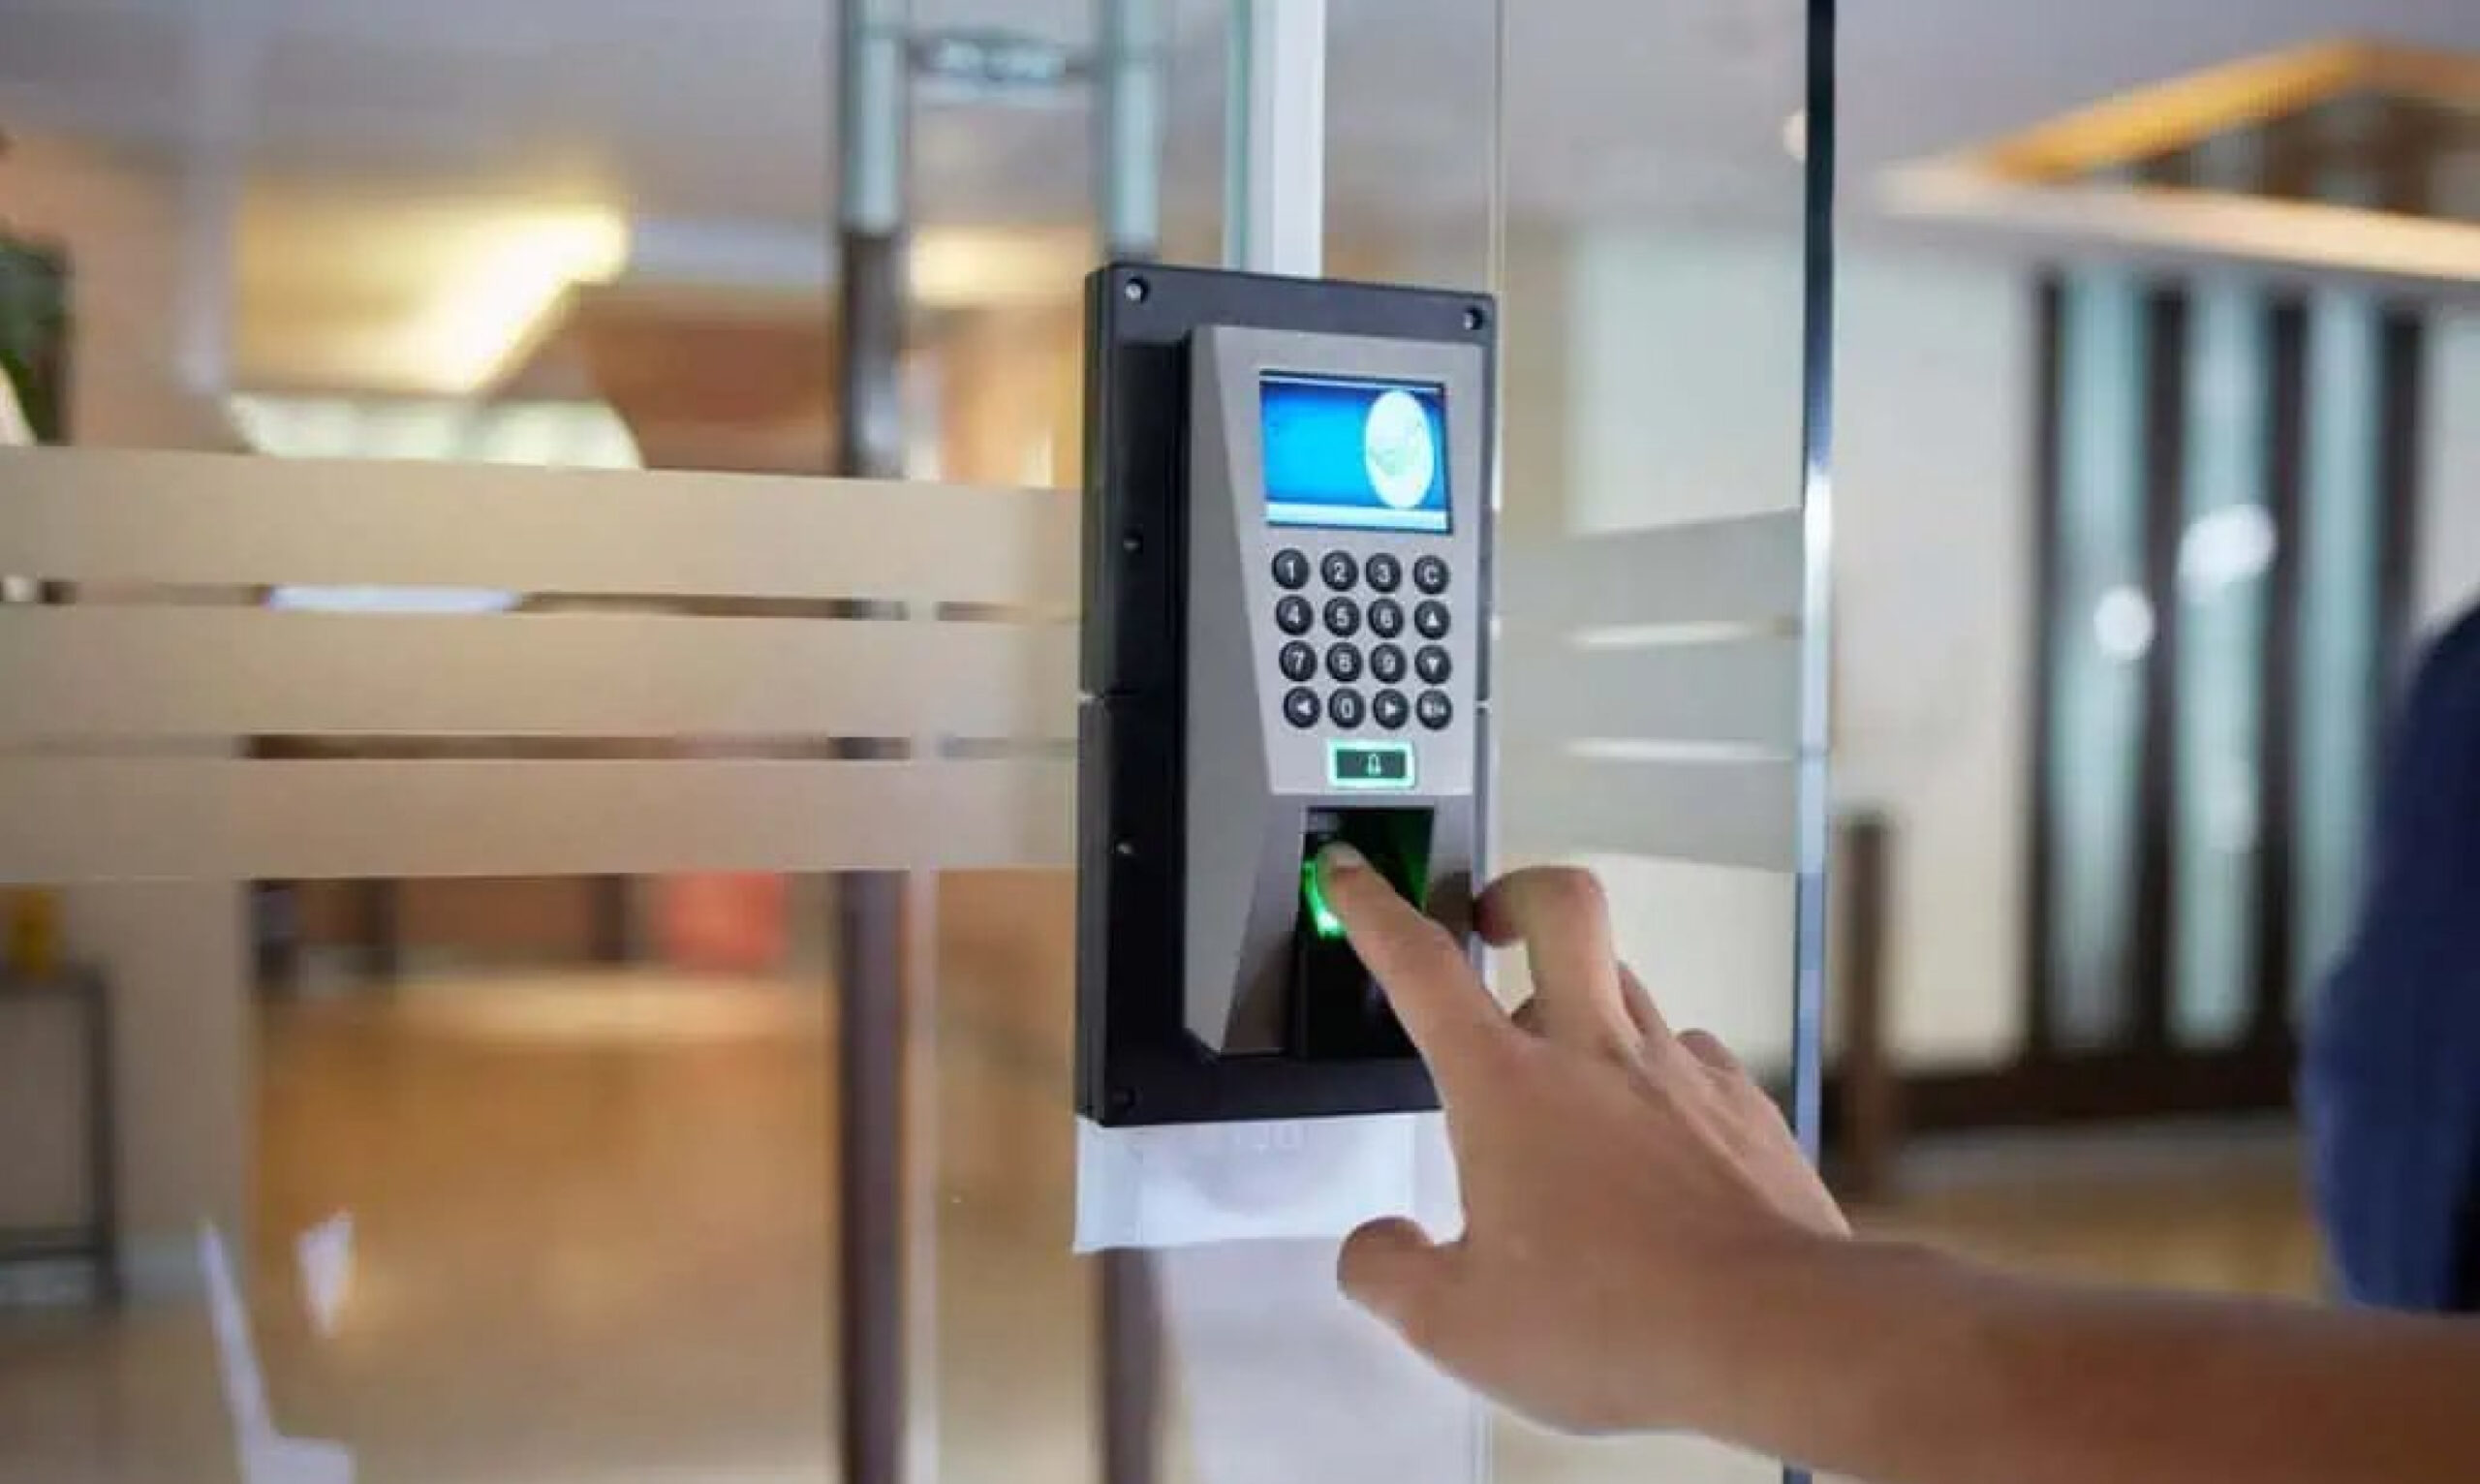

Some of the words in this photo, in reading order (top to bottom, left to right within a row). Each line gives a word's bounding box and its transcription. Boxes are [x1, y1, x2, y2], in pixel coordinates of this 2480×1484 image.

[1286, 560, 1295, 582] 1
[1334, 562, 1347, 582] 2
[1378, 564, 1389, 583] 3
[1423, 564, 1440, 584] C
[1286, 604, 1301, 624] 4
[1336, 606, 1349, 627] 5
[1380, 607, 1394, 629] 6
[1291, 650, 1305, 673] 7
[1339, 653, 1352, 672] 8
[1382, 654, 1395, 673] 9
[1341, 696, 1354, 718] 0
